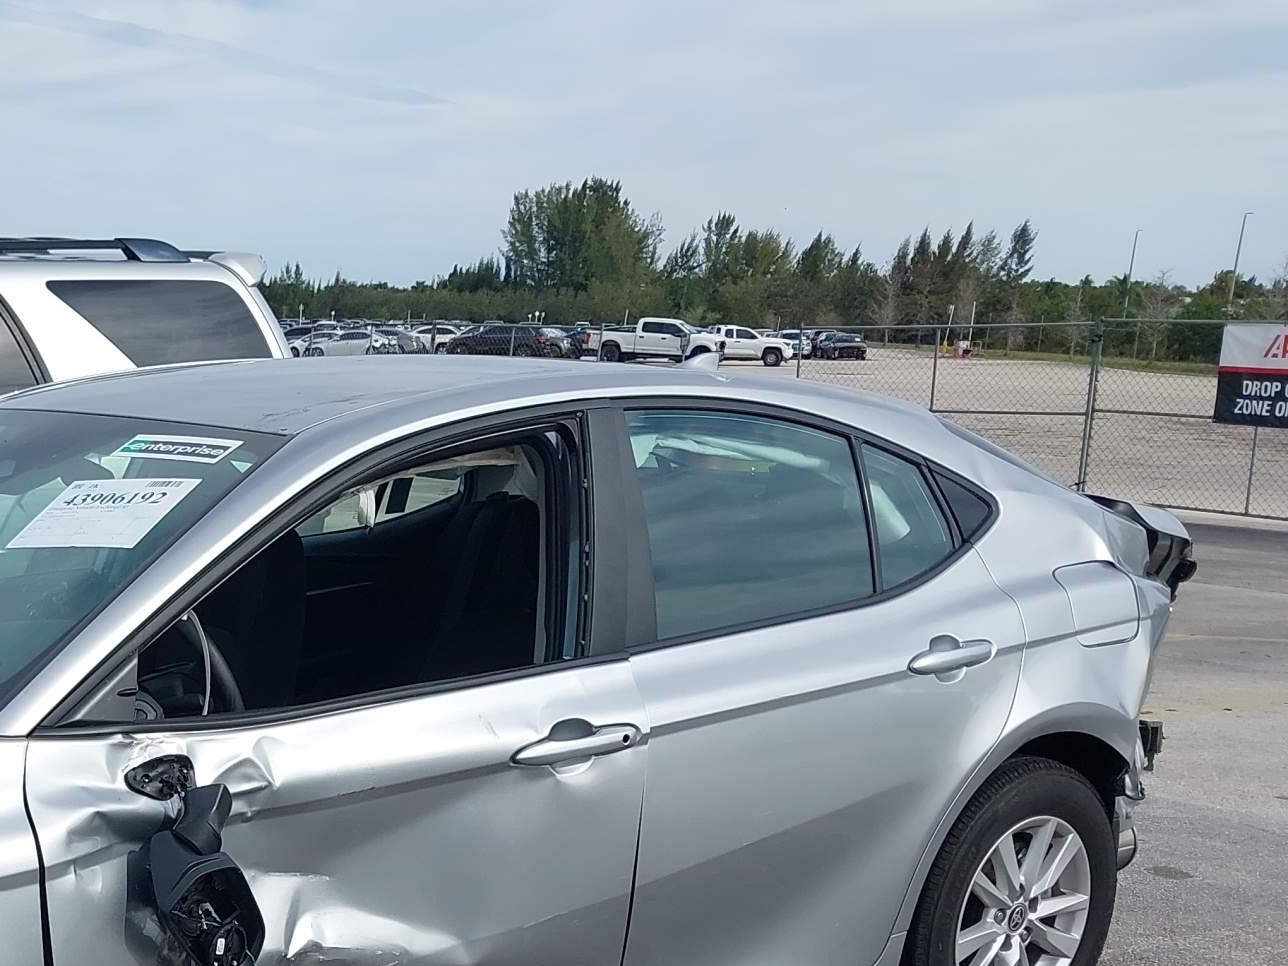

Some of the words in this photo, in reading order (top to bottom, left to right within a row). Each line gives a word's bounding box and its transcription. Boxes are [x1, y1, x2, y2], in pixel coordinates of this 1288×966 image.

[1242, 380, 1281, 397] DROP
[1234, 399, 1272, 416] ZONE
[126, 441, 224, 457] enterprise
[63, 491, 169, 506] 43906192
